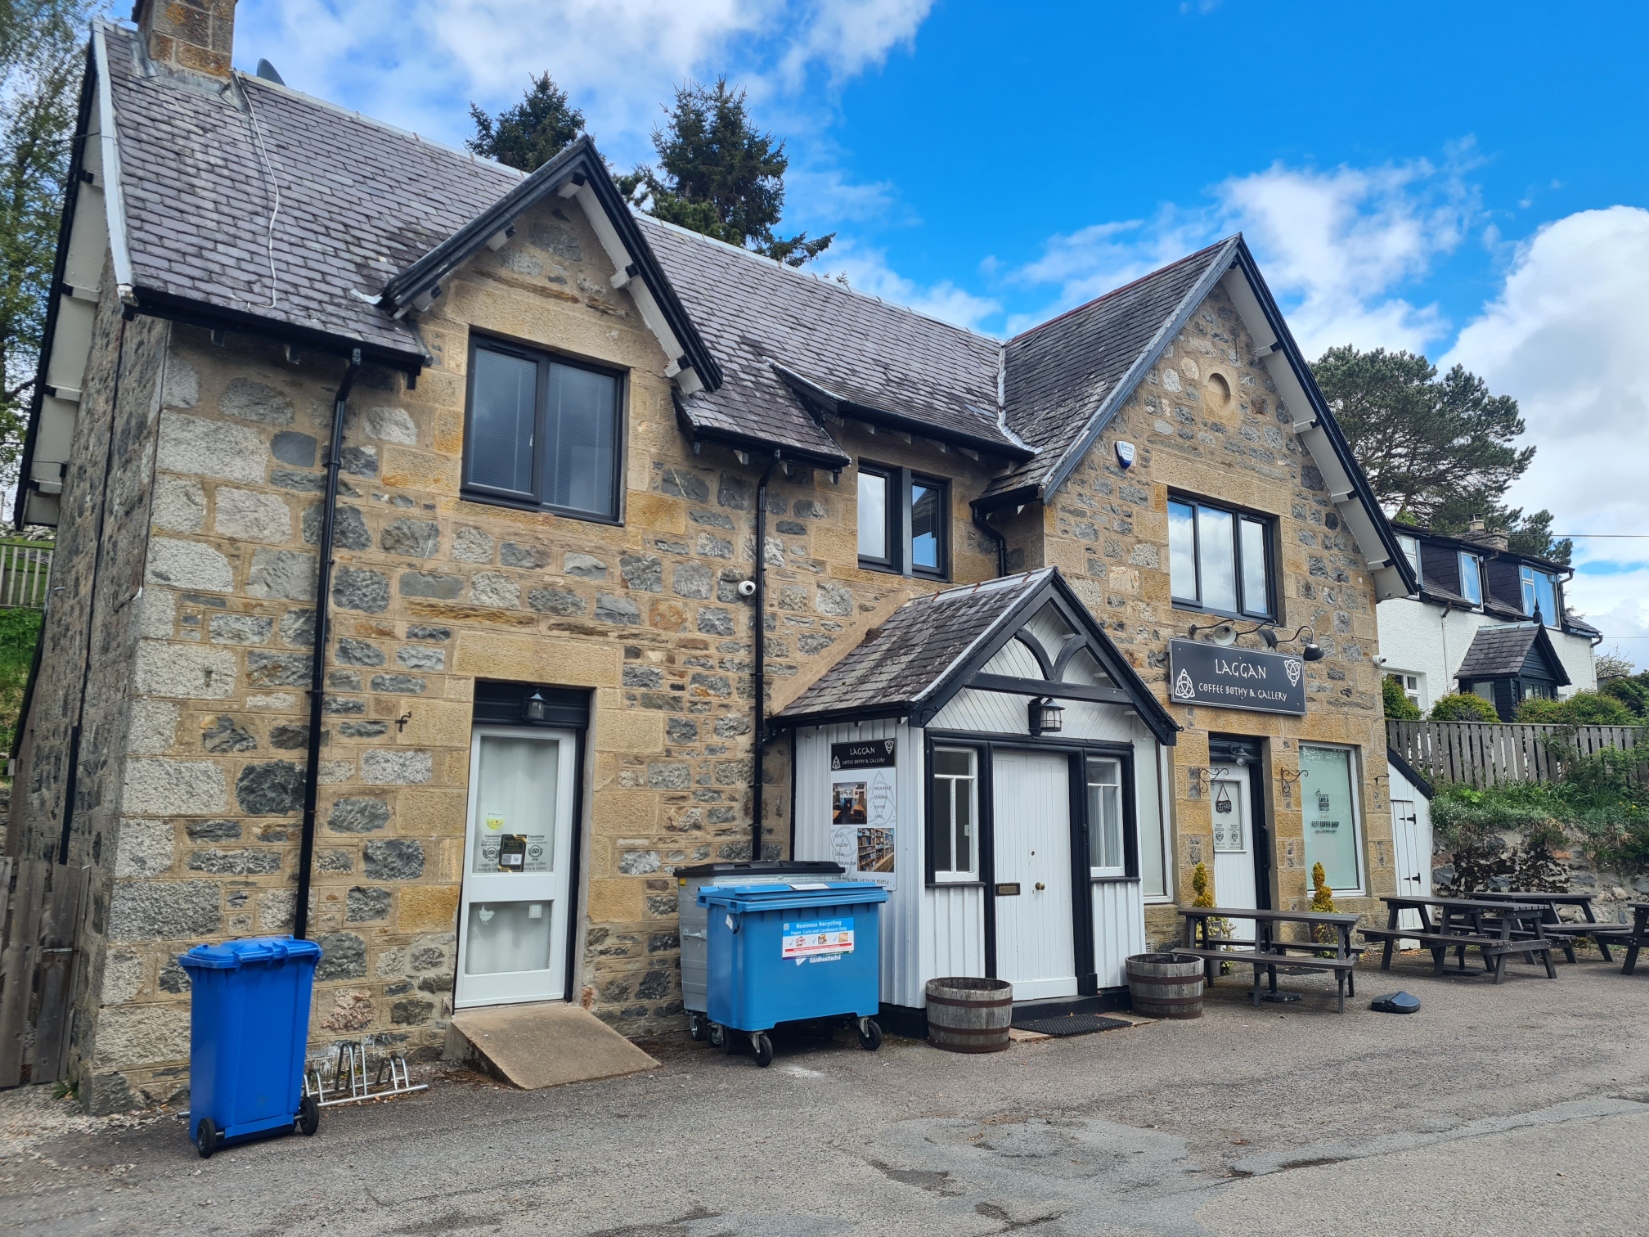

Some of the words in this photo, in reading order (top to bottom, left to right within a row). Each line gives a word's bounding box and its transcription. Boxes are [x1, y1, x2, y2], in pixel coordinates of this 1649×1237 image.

[1215, 659, 1266, 679] LAGGAN
[1198, 682, 1224, 694] COFFEE
[1225, 685, 1248, 697] BOTHY
[1249, 688, 1256, 697] &
[1257, 689, 1287, 702] GALLERY
[850, 747, 875, 756] LAGGAN
[819, 920, 842, 928] Recycling
